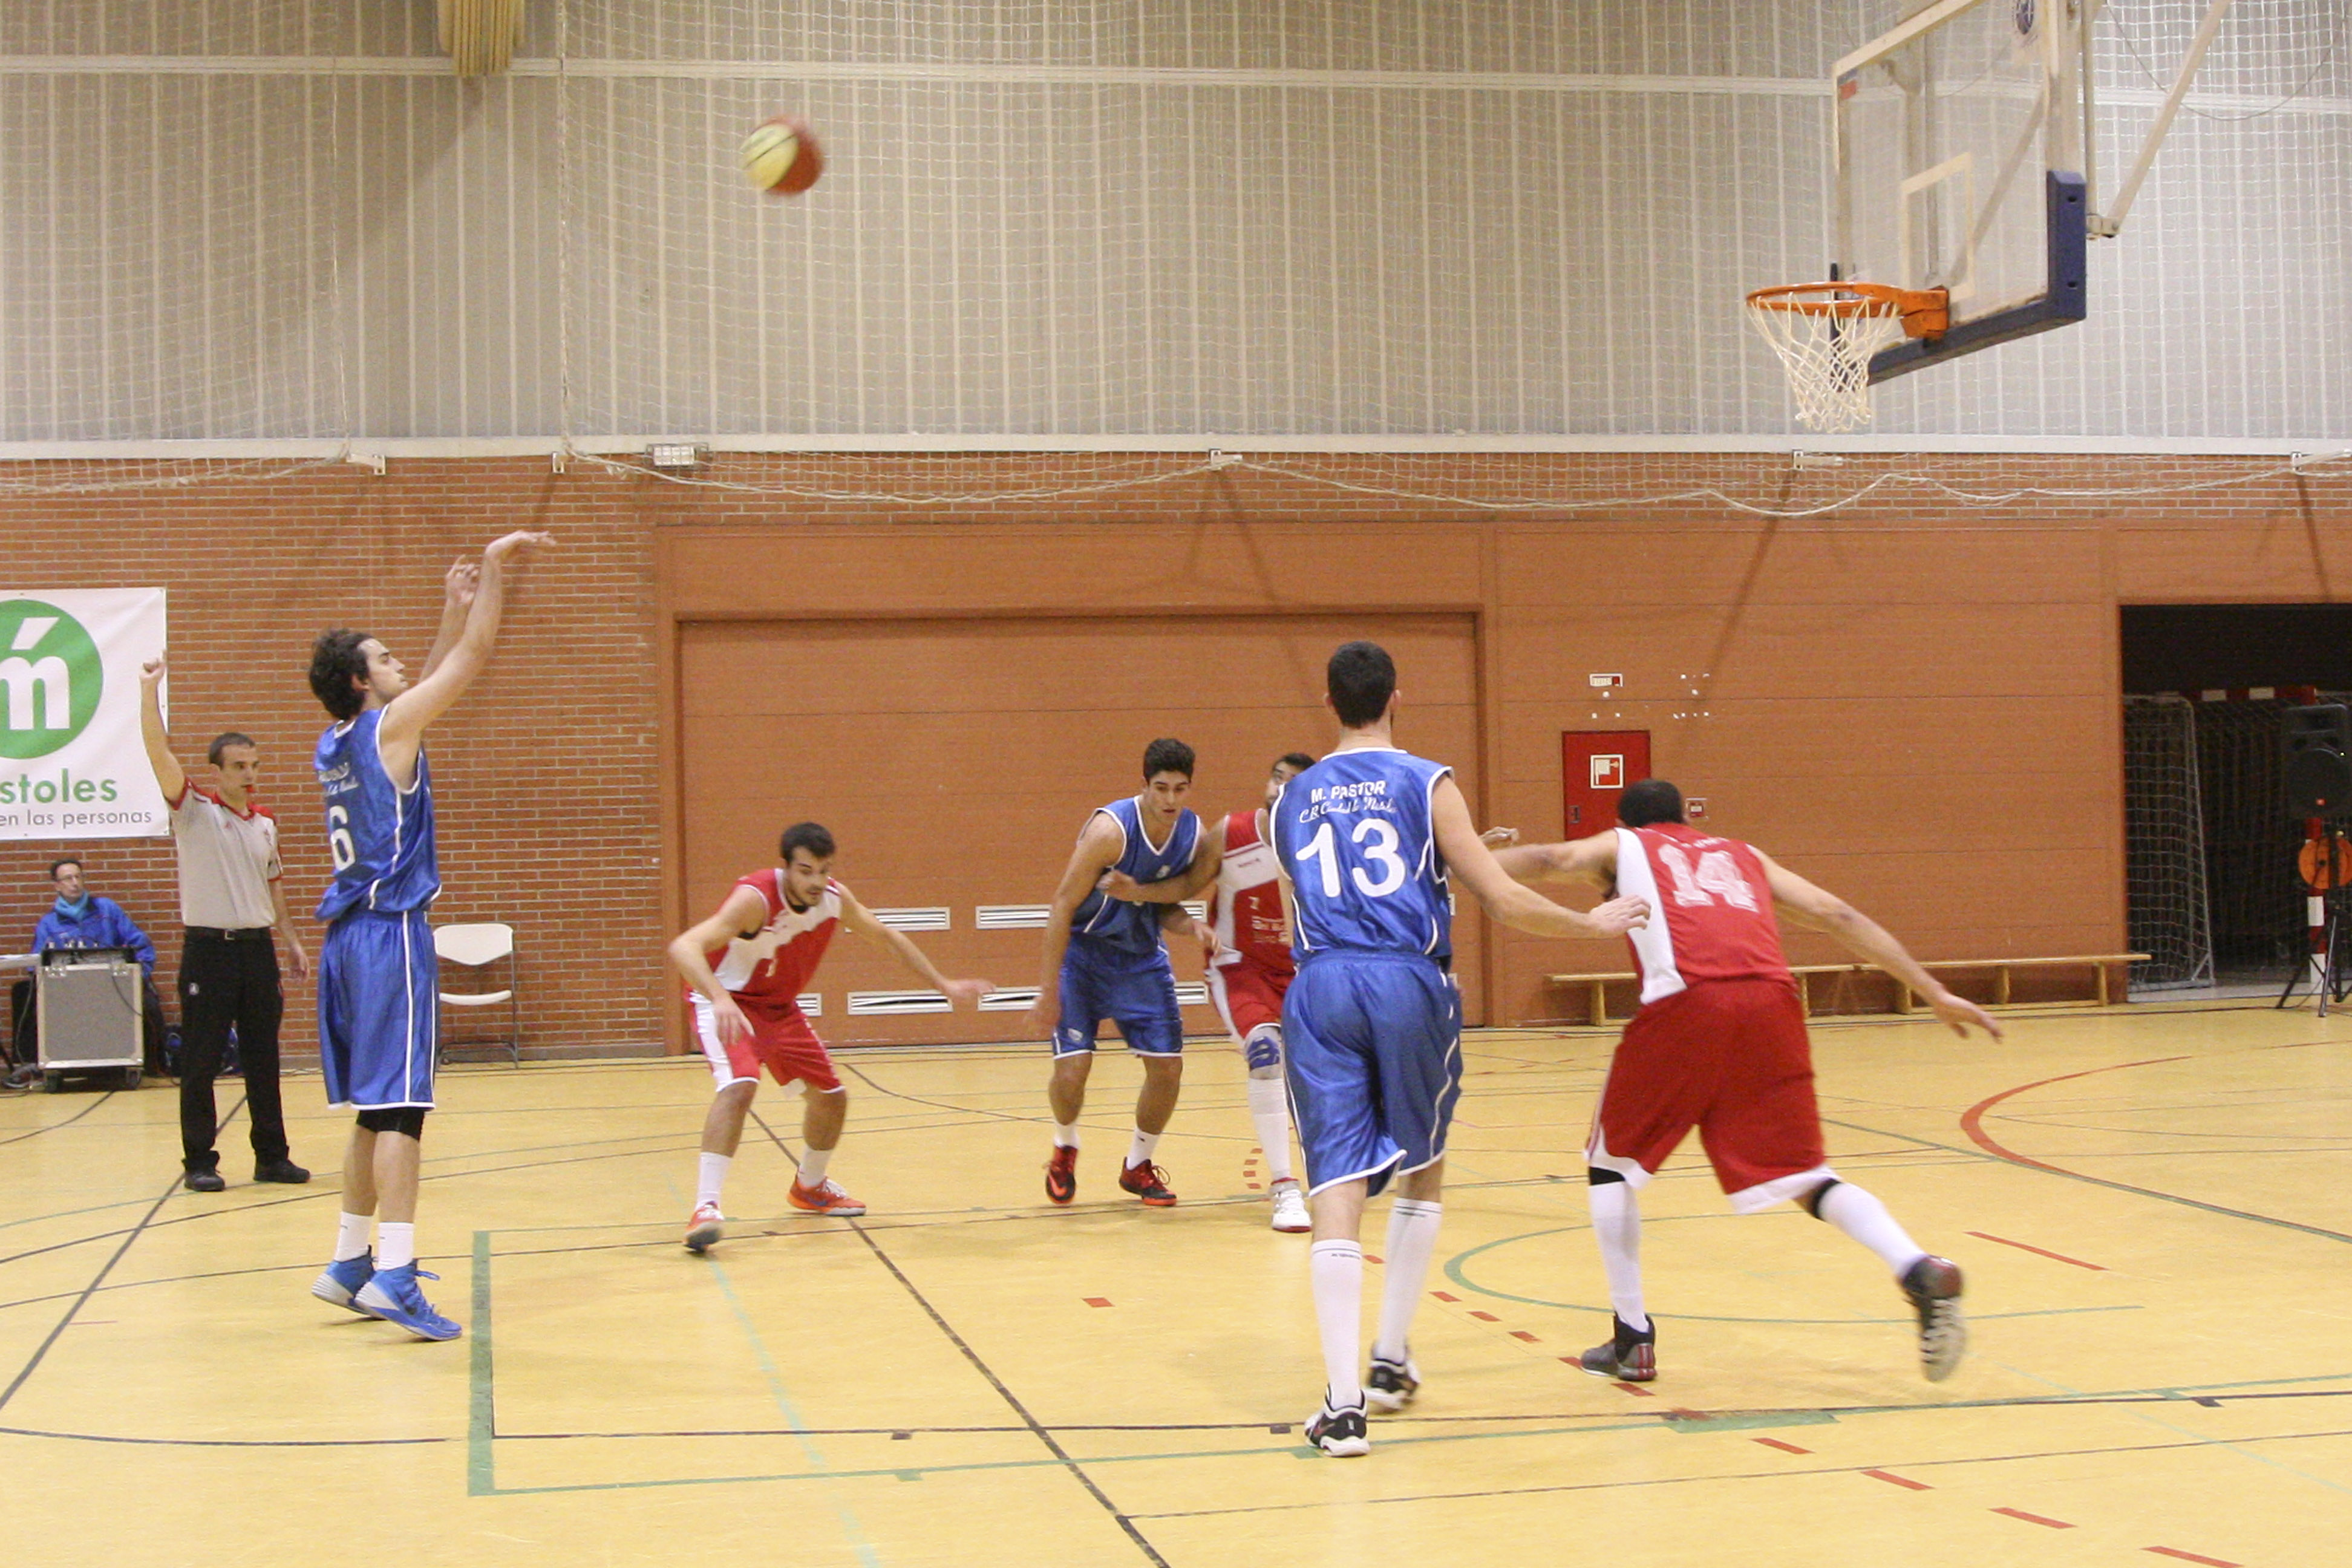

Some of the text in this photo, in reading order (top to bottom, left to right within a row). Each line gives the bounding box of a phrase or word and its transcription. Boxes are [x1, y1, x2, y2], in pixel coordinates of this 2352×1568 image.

[27, 809, 54, 826] las
[62, 811, 152, 829] personas
[1331, 780, 1386, 800] PASTOR
[329, 805, 356, 871] 6
[1295, 817, 1406, 898] 13
[1658, 843, 1760, 913] 14
